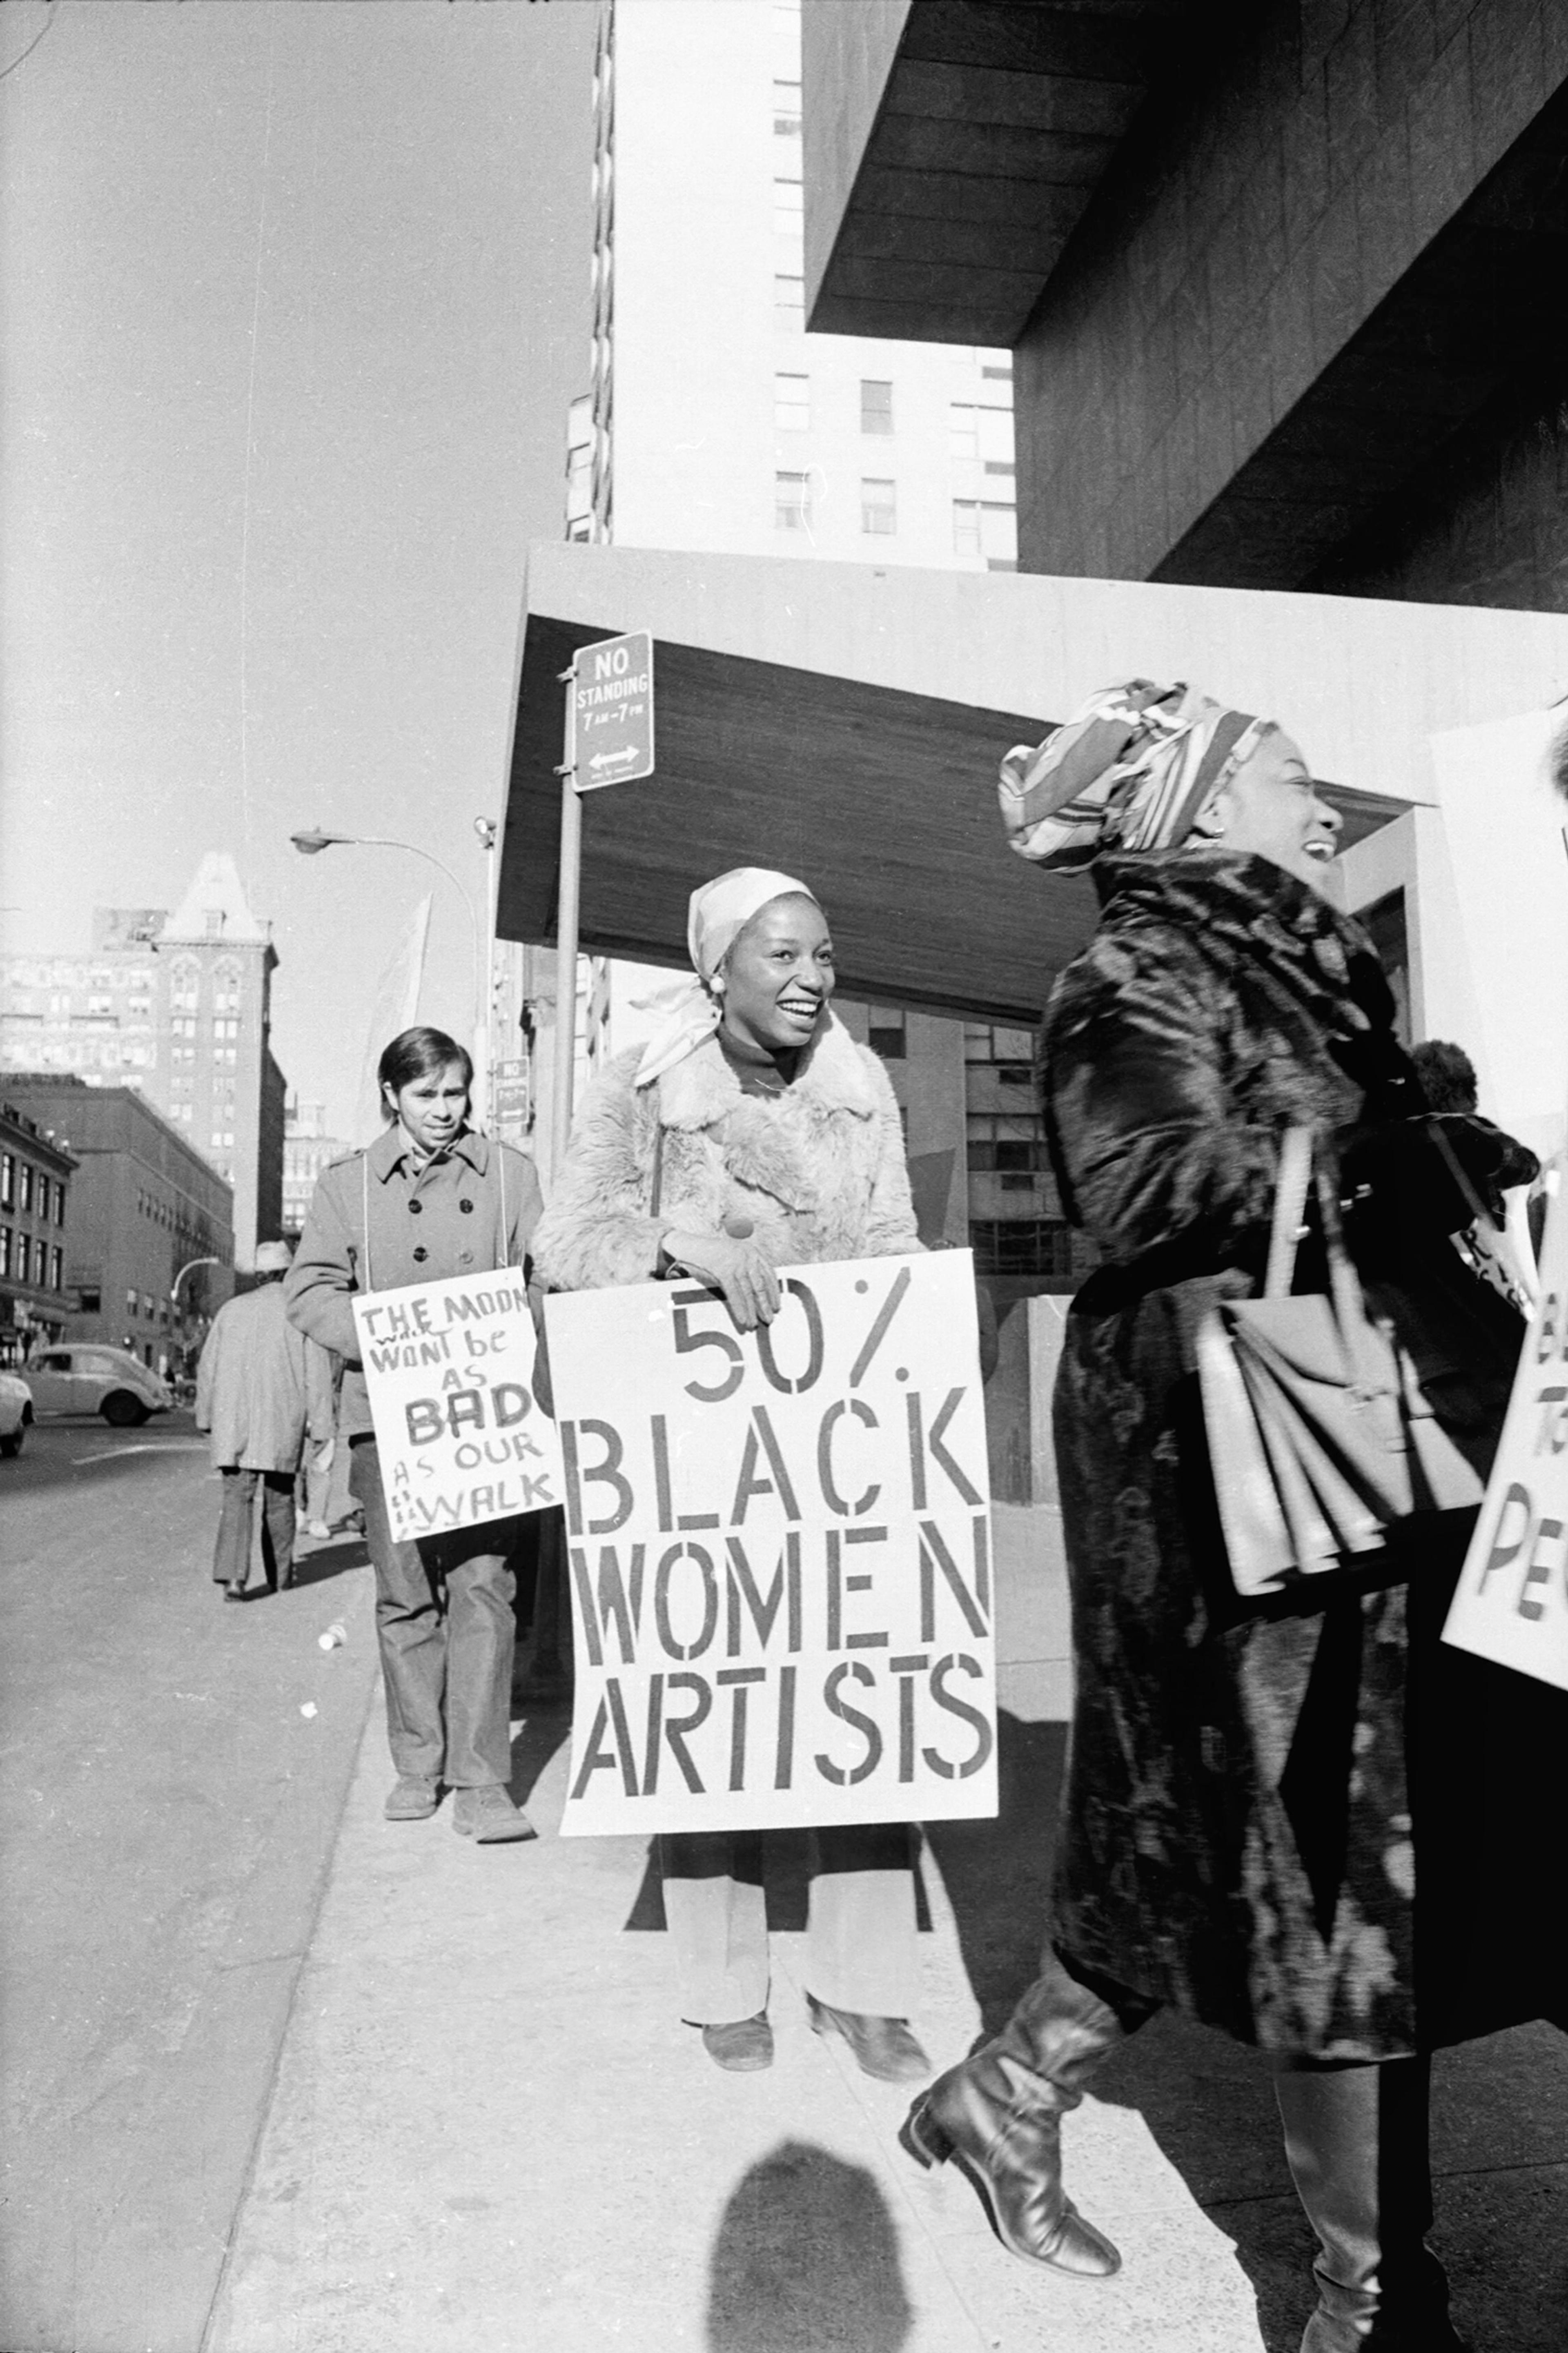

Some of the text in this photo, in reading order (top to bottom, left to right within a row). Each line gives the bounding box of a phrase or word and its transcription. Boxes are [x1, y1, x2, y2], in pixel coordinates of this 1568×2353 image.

[595, 648, 628, 680] NO
[577, 674, 647, 709] STANDING
[361, 1298, 432, 1336] THE
[671, 1266, 911, 1402] 50%
[370, 1329, 506, 1373] WONT be
[441, 1364, 488, 1390] AS
[405, 1383, 531, 1446] BAD
[393, 1432, 543, 1487] AS OUR
[560, 1387, 985, 1536] BLACK
[416, 1473, 555, 1526] WALK
[569, 1514, 990, 1667] WOMEN
[569, 1652, 993, 1799] ARTISTS
